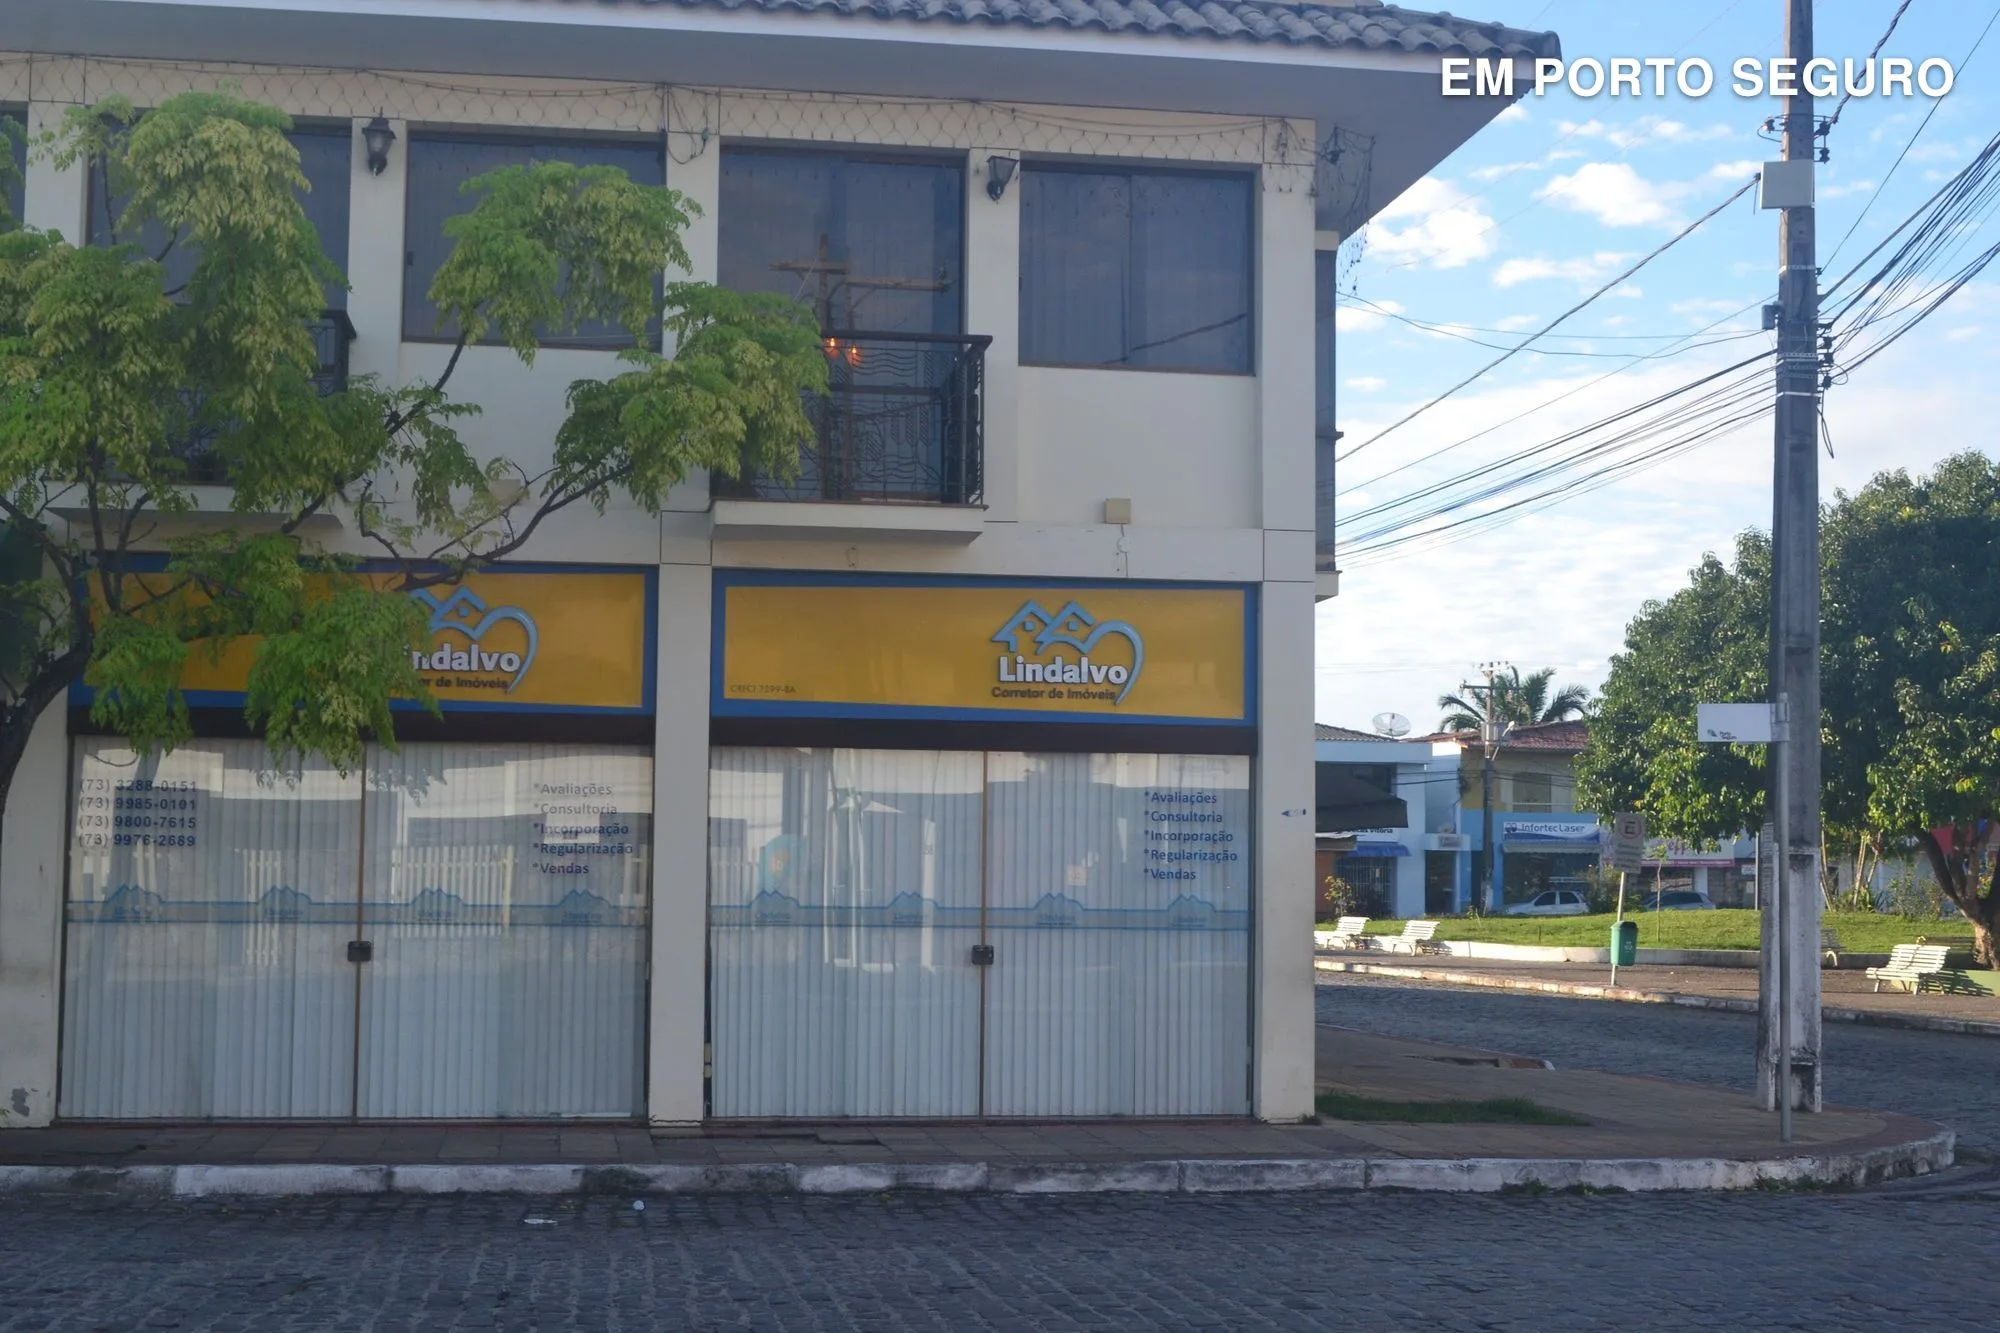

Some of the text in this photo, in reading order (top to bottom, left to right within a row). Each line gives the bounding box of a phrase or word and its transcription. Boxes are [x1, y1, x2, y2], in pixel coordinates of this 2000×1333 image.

[403, 643, 521, 672] ndalvo
[999, 655, 1128, 684] Lindalvo
[435, 677, 453, 688] de
[991, 687, 1117, 701] Corretor de Imóveis
[80, 779, 197, 793] (73) 3288-0151
[80, 797, 109, 811] (73)
[79, 815, 196, 829] (73) 9800-7615
[78, 833, 108, 848] (73)
